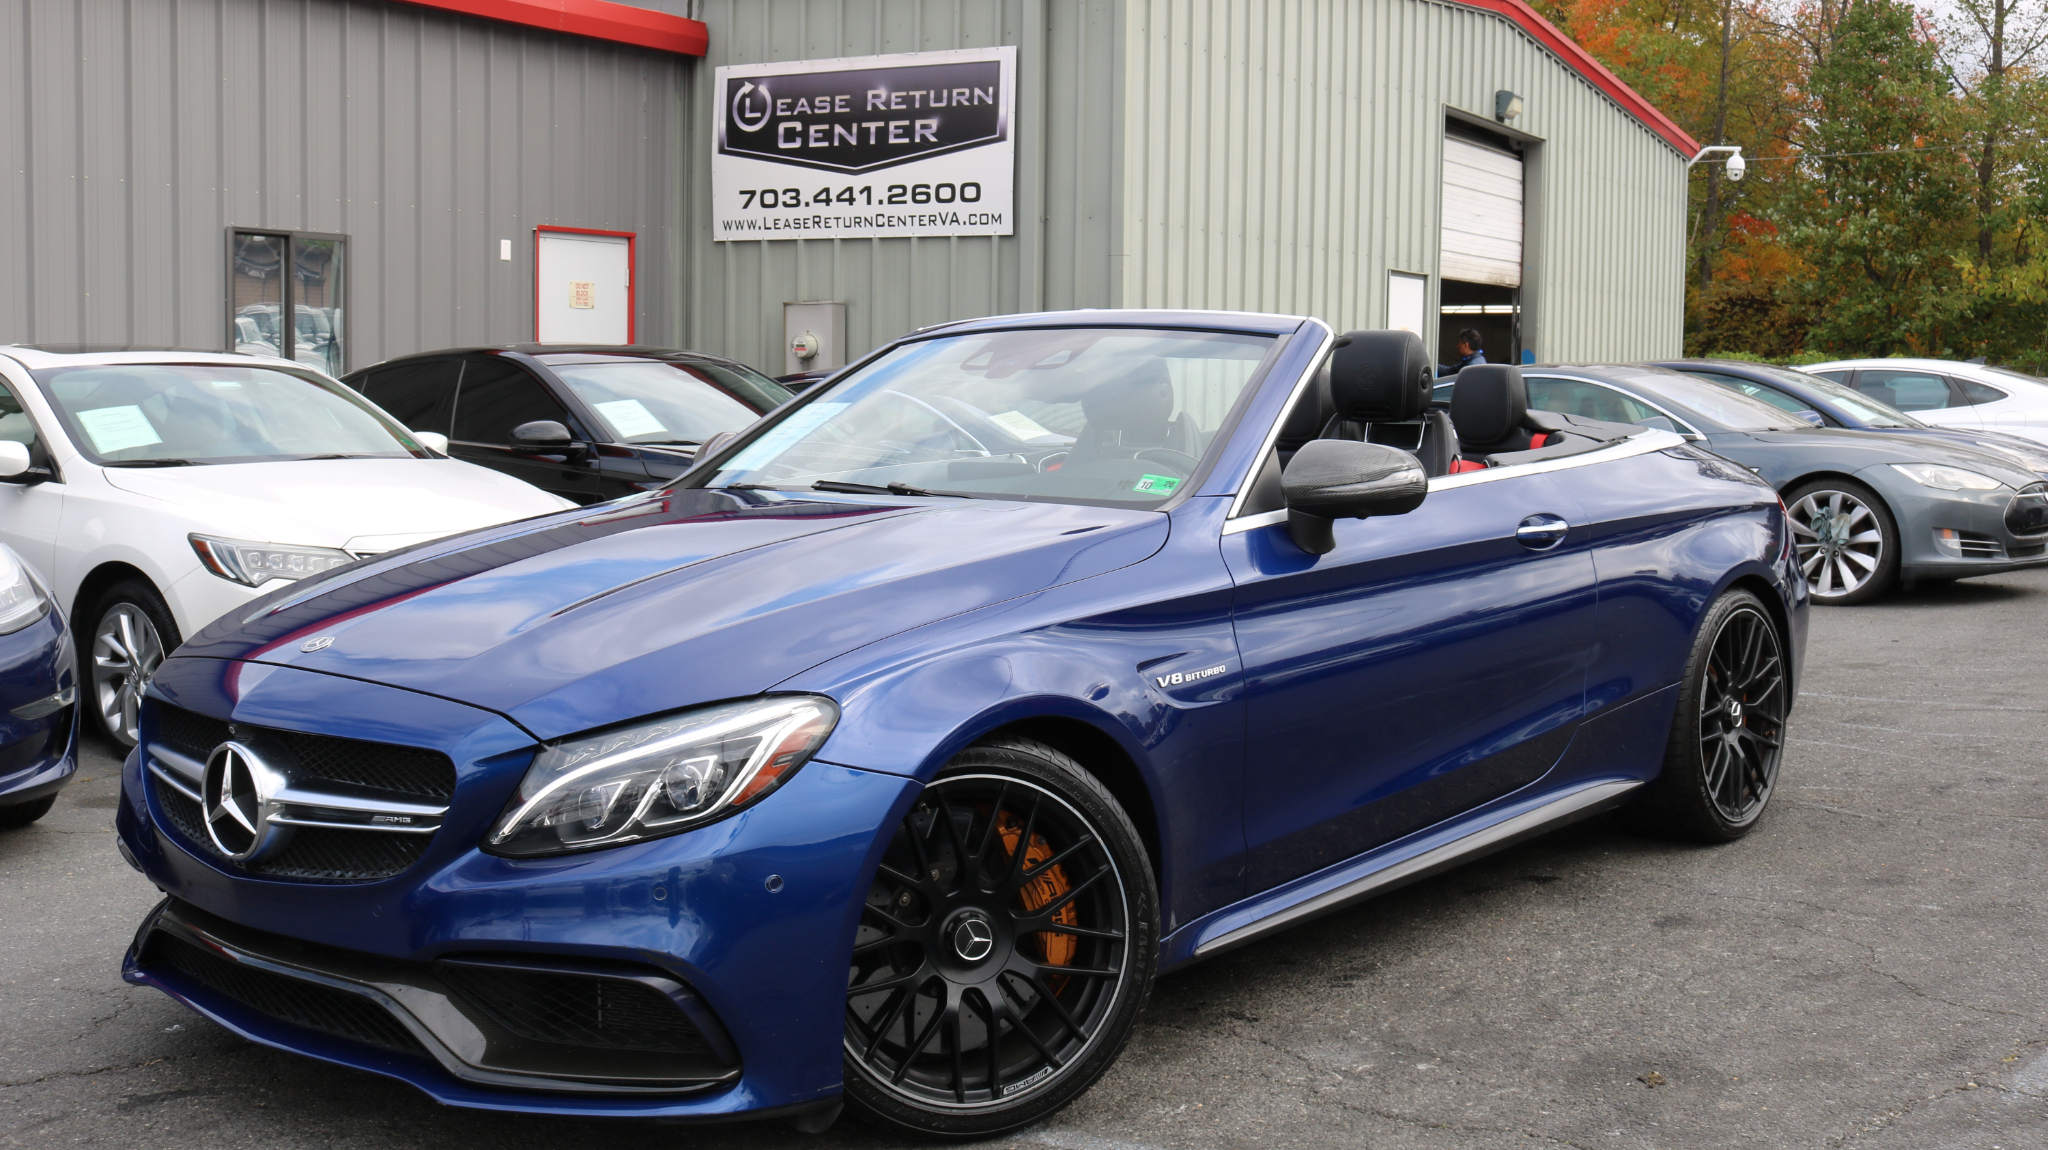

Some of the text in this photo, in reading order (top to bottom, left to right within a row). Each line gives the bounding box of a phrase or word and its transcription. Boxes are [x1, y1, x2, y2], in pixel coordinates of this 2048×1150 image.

[866, 86, 993, 111] RETURN
[777, 118, 939, 149] CENTER
[738, 182, 981, 209] 703.441.2600
[1140, 481, 1153, 490] 10
[1156, 665, 1226, 689] V8 BITURBO
[384, 815, 411, 824] AMG
